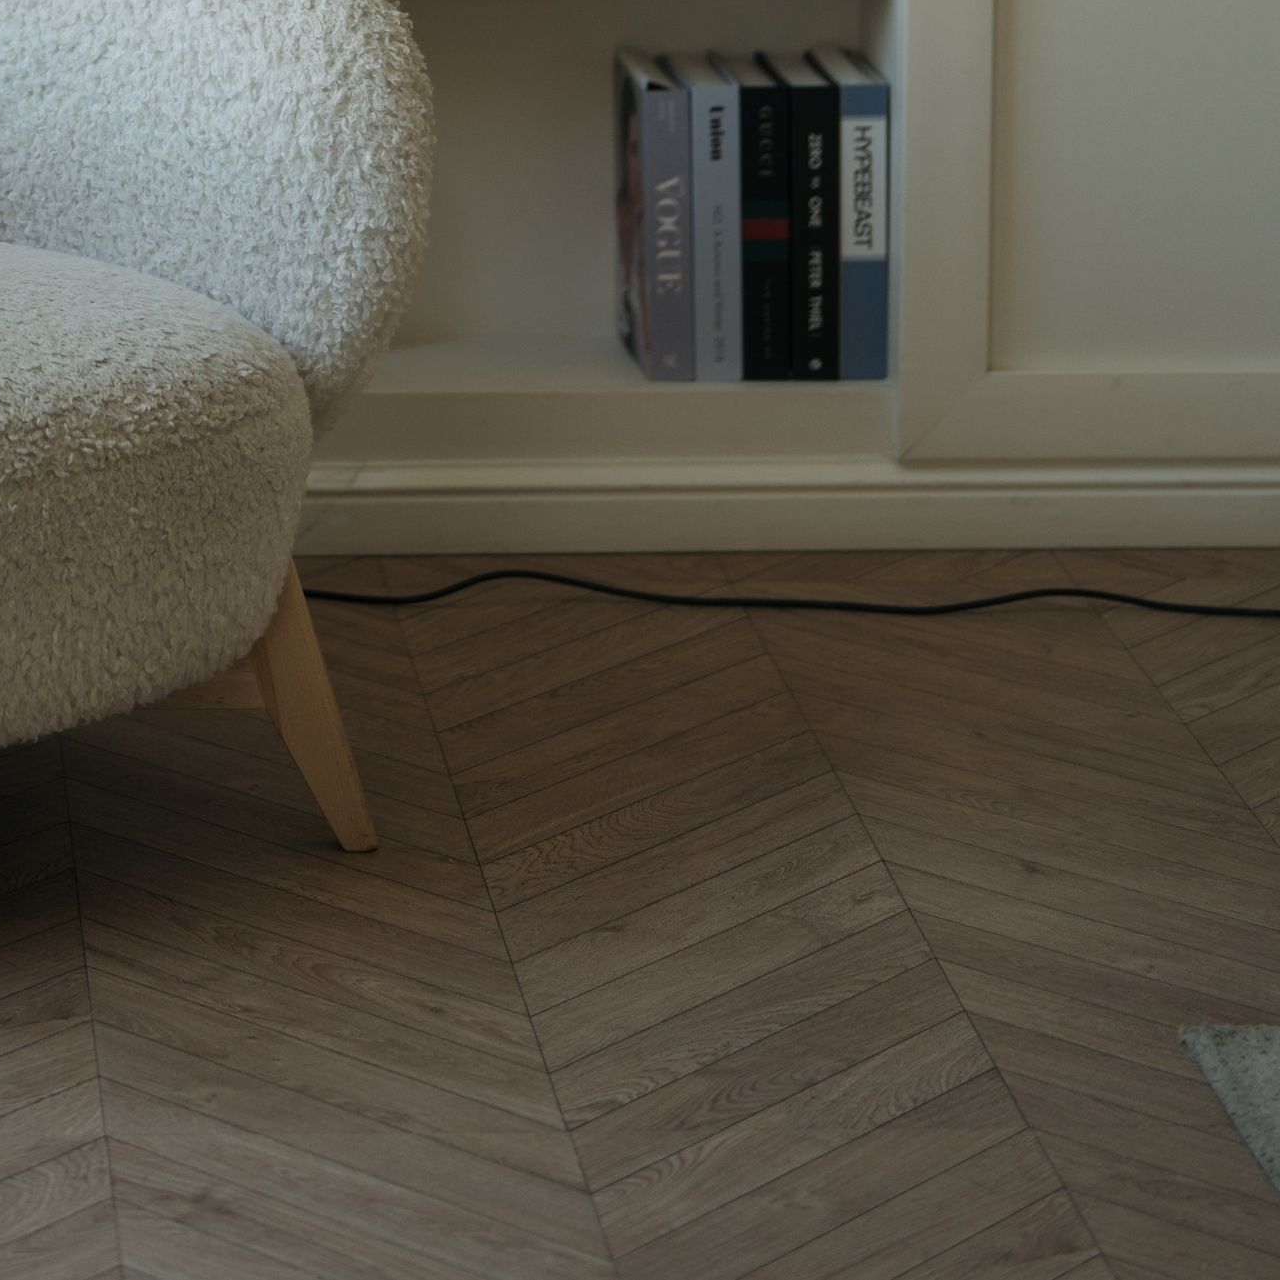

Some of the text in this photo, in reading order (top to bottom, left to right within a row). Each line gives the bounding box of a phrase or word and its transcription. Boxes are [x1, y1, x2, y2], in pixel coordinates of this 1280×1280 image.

[758, 104, 774, 177] GUCCI
[808, 133, 823, 169] ZERO
[808, 196, 822, 228] ONE
[853, 126, 873, 249] HYPEBEAST
[655, 176, 682, 293] VOGUE
[808, 250, 823, 332] PETER THIEL
